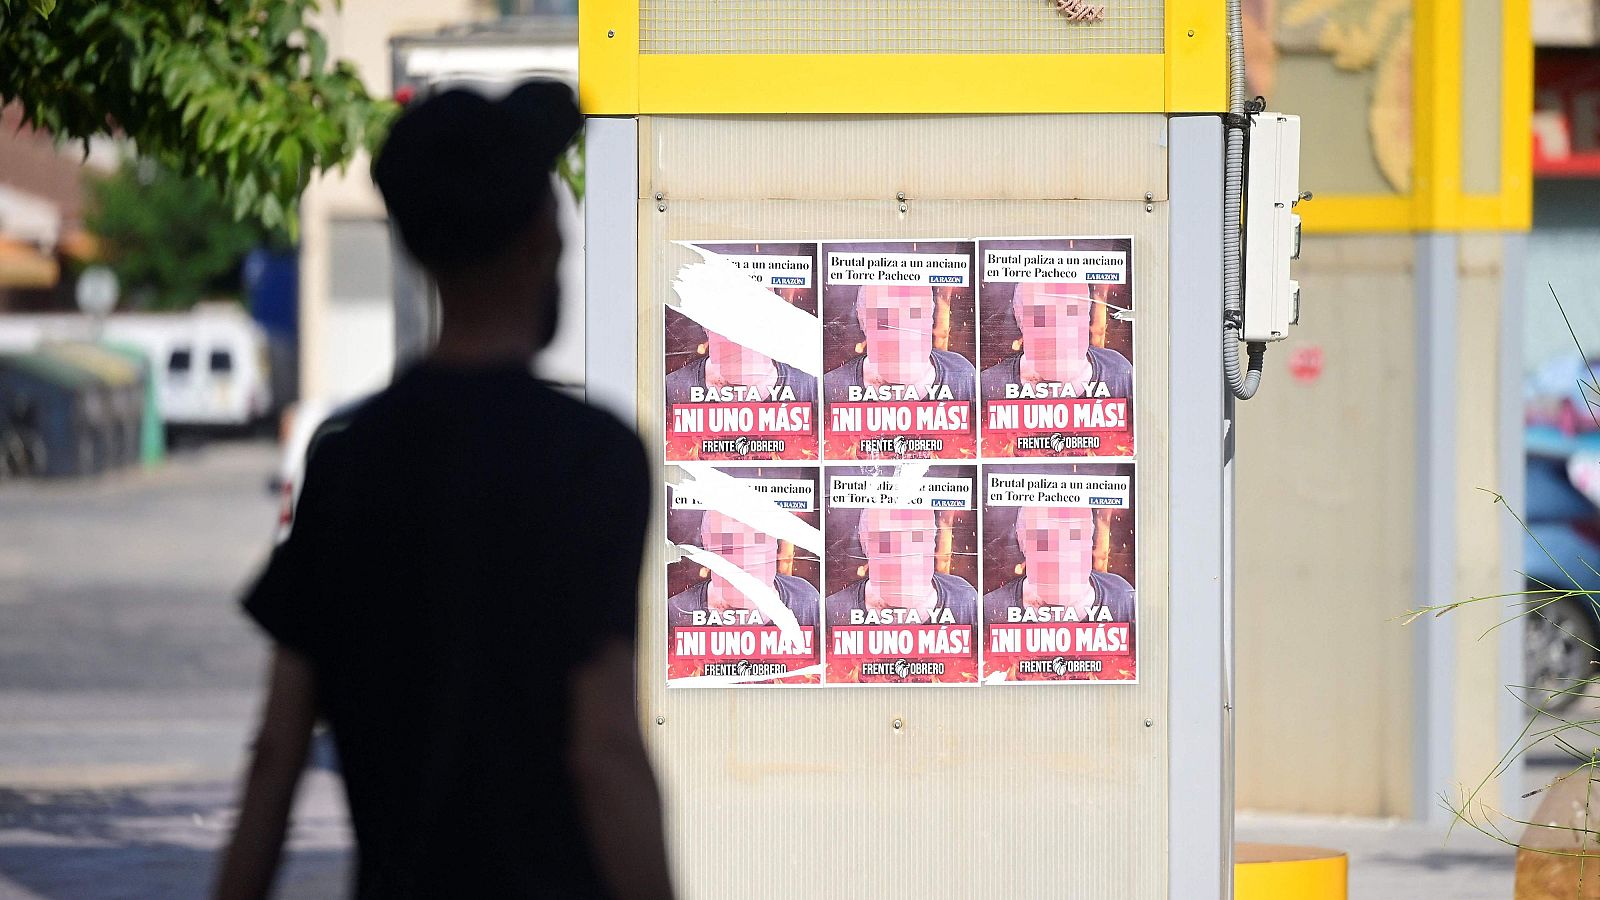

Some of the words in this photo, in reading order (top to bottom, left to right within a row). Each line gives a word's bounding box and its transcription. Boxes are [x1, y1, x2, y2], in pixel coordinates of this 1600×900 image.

[752, 261, 765, 269] un
[769, 260, 809, 270] anciano
[831, 257, 864, 267] Brutal
[868, 258, 898, 269] paliza
[926, 259, 967, 269] anciano
[988, 254, 1021, 264] Brutal
[1024, 255, 1054, 266] paliza
[1083, 256, 1123, 266] anciano
[831, 272, 842, 280] en
[846, 270, 874, 280] Torre
[878, 271, 920, 281] Pacheco
[987, 269, 999, 277] en
[1002, 268, 1031, 277] Torre
[1035, 268, 1077, 278] Pacheco
[691, 386, 762, 402] BASTA
[766, 386, 796, 401] YA
[849, 385, 920, 401] BASTA
[925, 385, 954, 400] YA
[1006, 382, 1077, 398] BASTA
[1082, 382, 1111, 397] YA
[674, 408, 703, 432] ¡NI
[709, 408, 753, 432] UNO
[759, 403, 810, 432] MÁS!
[833, 407, 861, 431] ¡NI
[867, 407, 911, 431] UNO
[917, 402, 968, 430] MÁS!
[989, 405, 1018, 429] ¡NI
[1024, 404, 1068, 428] UNO
[1074, 400, 1125, 428] MÁS!
[702, 441, 735, 452] FRENTE
[750, 441, 784, 451] OBRERO
[860, 440, 893, 451] FRENTE
[909, 440, 943, 450] OBRERO
[1018, 437, 1050, 448] FRENTE
[1066, 437, 1099, 448] OBRERO
[771, 484, 811, 494] anciano
[834, 480, 866, 490] Brutal
[928, 482, 969, 492] anciano
[992, 478, 1024, 488] Brutal
[1028, 479, 1058, 490] paliza
[1086, 480, 1126, 490] anciano
[833, 495, 844, 503] en
[991, 493, 1002, 501] en
[1005, 491, 1035, 501] Torre
[1038, 492, 1080, 502] Pacheco
[693, 609, 764, 625] BASTA
[851, 608, 922, 624] BASTA
[927, 608, 956, 623] YA
[1008, 606, 1079, 622] BASTA
[1084, 606, 1113, 622] YA
[676, 632, 705, 655] ¡NI
[711, 631, 755, 655] UNO
[834, 631, 863, 655] ¡NI
[869, 630, 913, 654] UNO
[919, 626, 970, 653] MÁS!
[992, 629, 1021, 652] ¡NI
[1026, 628, 1071, 652] UNO
[1076, 624, 1128, 651] MÁS!
[704, 664, 736, 675] FRENTE
[752, 664, 787, 675] OBRERO
[863, 664, 895, 674] FRENTE
[911, 663, 944, 674] OBRERO
[1020, 661, 1052, 672] FRENTE
[1068, 661, 1101, 672] OBRERO
